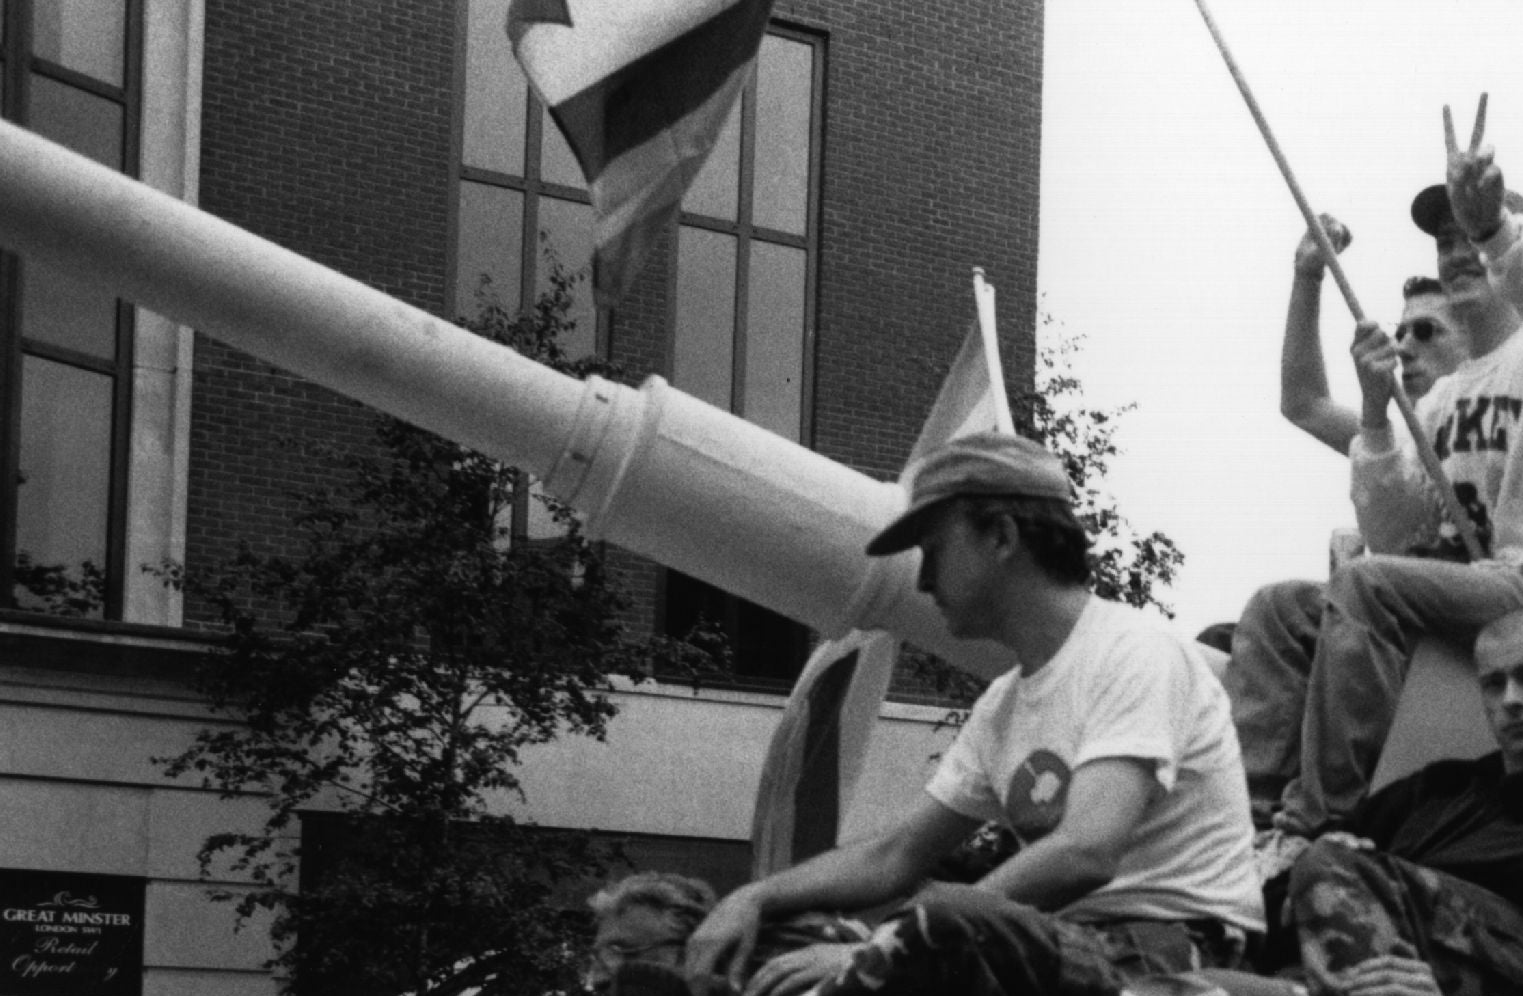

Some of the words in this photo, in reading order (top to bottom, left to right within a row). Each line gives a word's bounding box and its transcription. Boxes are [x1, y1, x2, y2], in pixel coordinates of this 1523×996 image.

[3, 908, 56, 923] GREAT
[63, 911, 131, 926] MINSTER
[35, 924, 78, 934] LONDON
[34, 936, 99, 955] Retail
